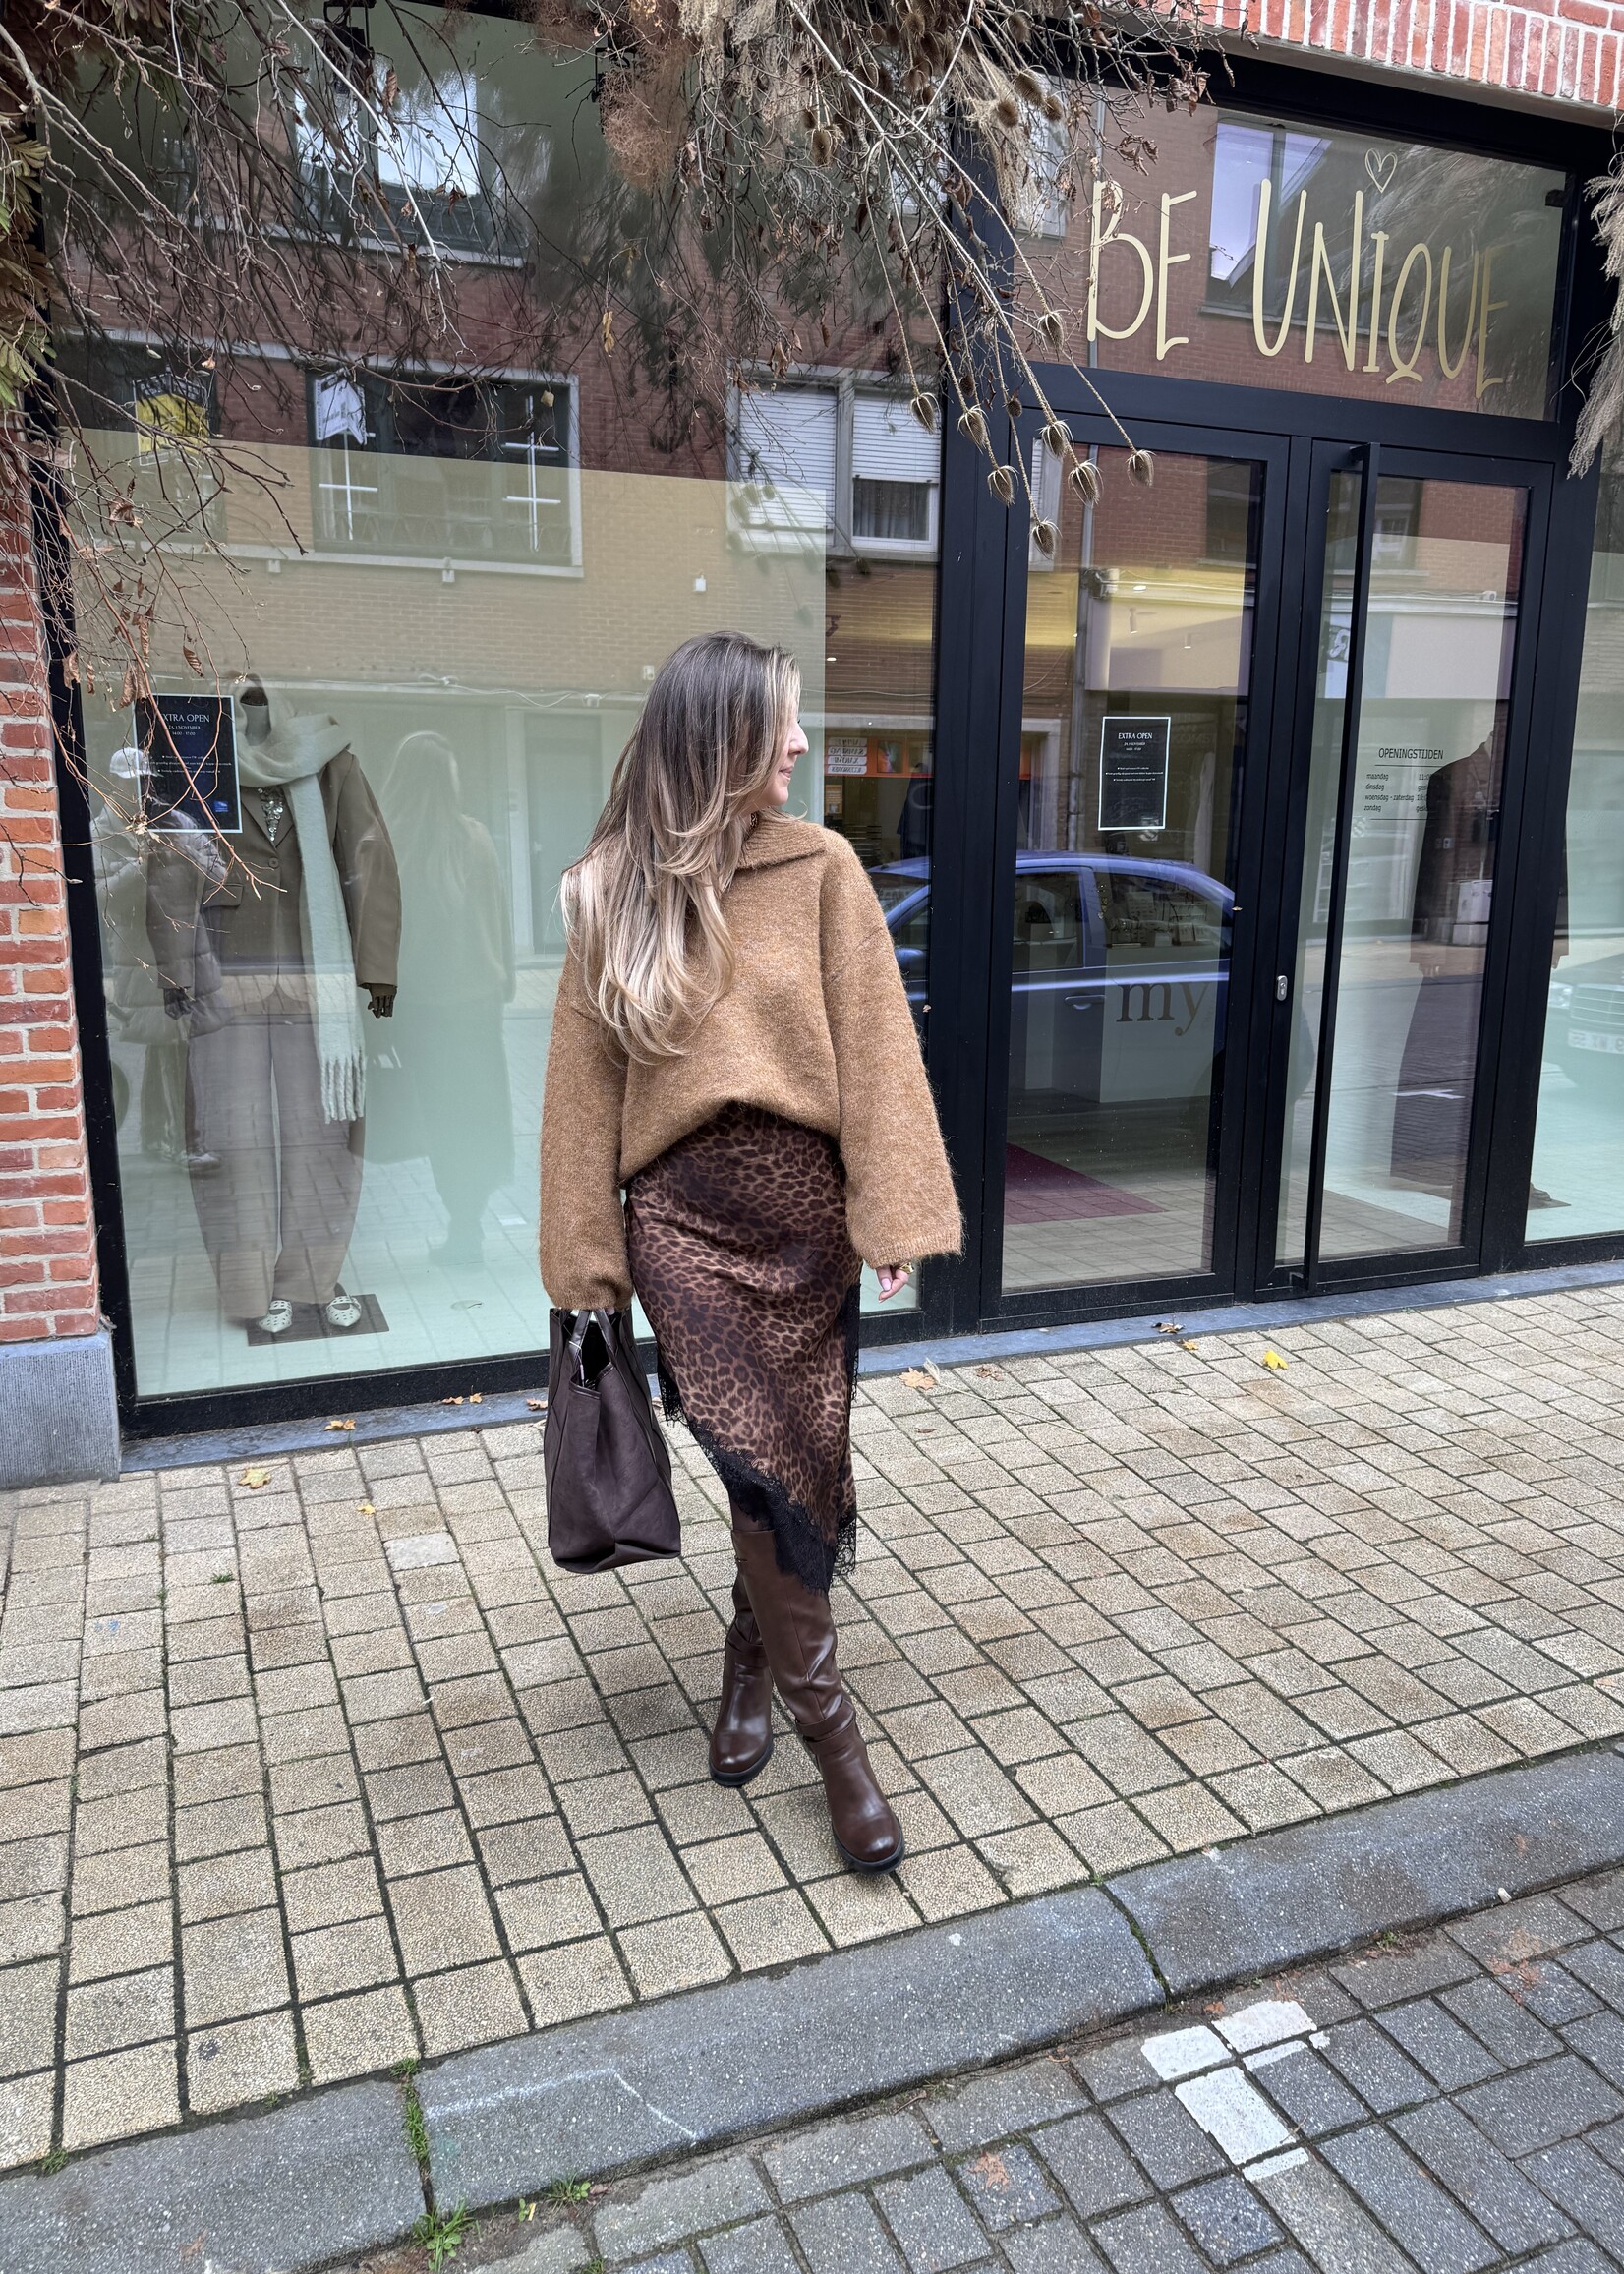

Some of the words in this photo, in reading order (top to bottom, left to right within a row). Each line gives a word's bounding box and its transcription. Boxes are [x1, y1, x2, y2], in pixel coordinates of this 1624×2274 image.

[1087, 179, 1197, 361] BE
[1252, 178, 1513, 399] UNIQUE
[161, 713, 185, 722] XTRA
[186, 714, 210, 723] OPEN
[1378, 748, 1444, 759] OPENINGSTIJDEN
[1365, 783, 1385, 791] dinsdag
[1116, 981, 1209, 1037] my
